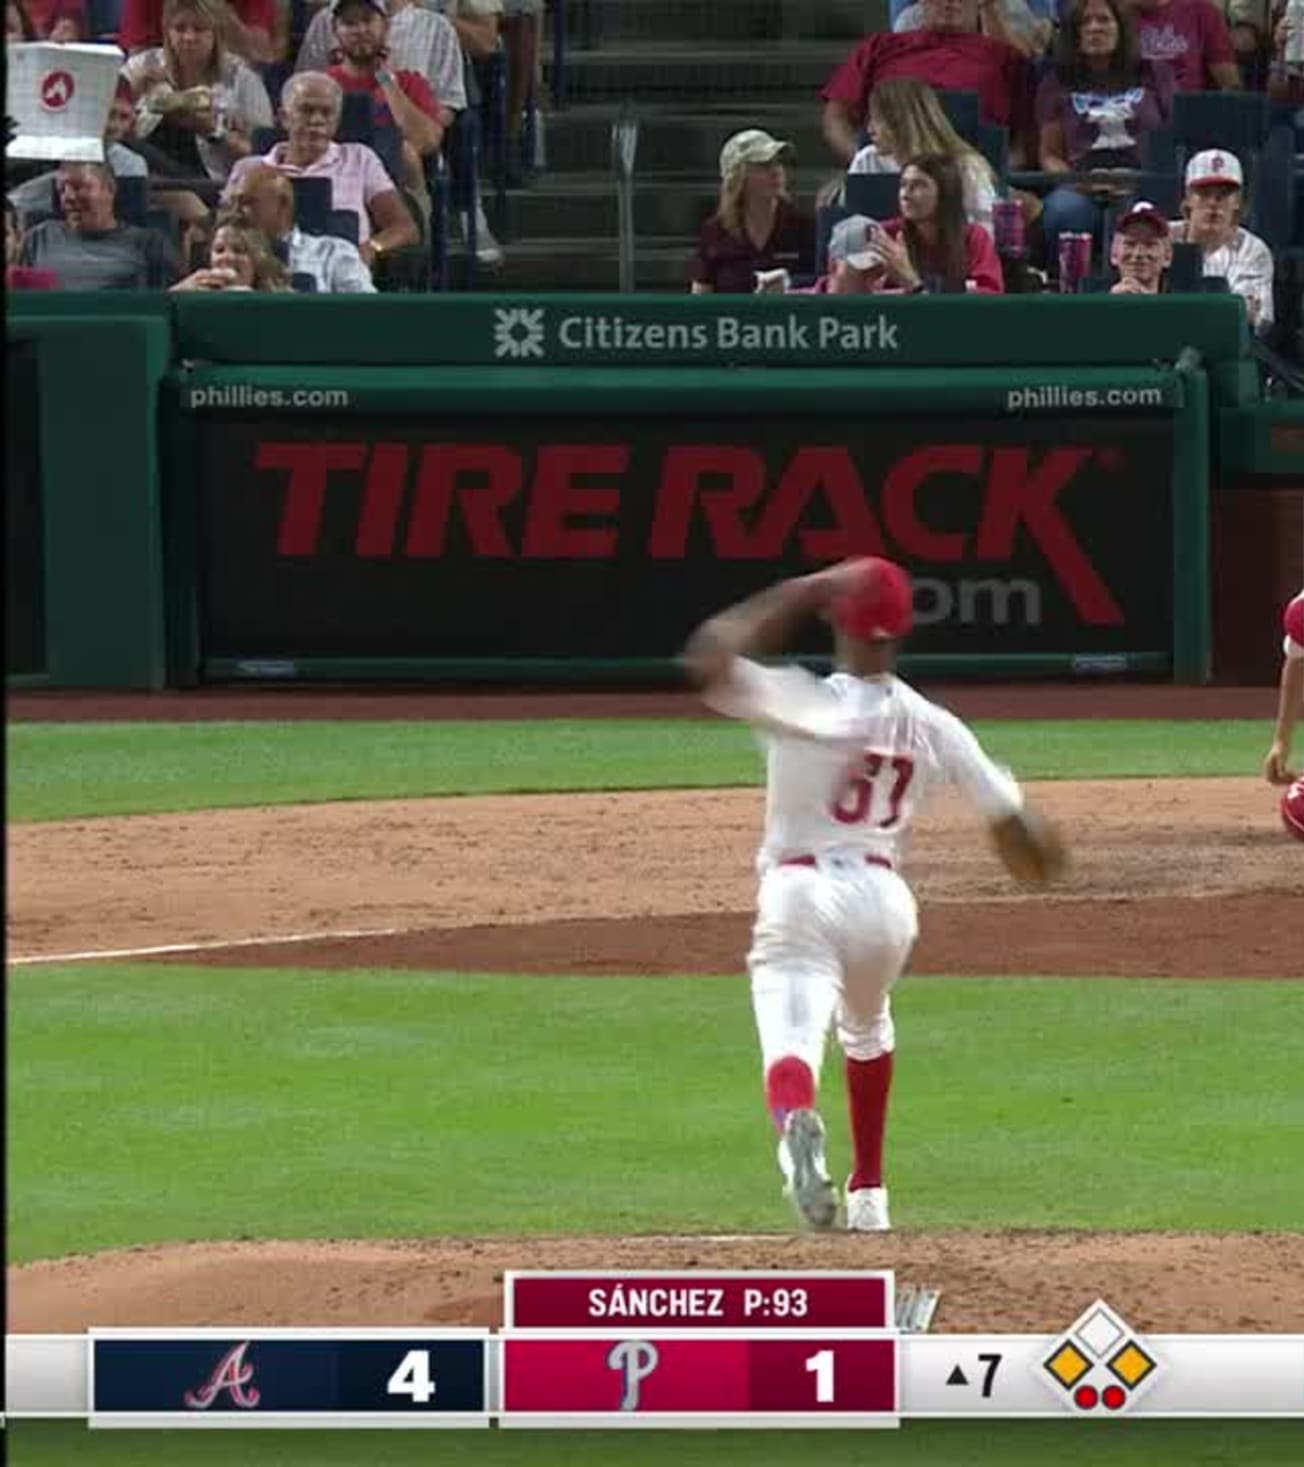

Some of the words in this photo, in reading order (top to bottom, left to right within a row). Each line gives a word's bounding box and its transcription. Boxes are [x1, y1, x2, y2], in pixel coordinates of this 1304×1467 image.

[558, 315, 714, 350] Citizens
[717, 314, 809, 350] Bank
[818, 314, 899, 350] Park
[189, 385, 349, 409] phillies.com
[1006, 386, 1162, 409] phillies.com
[253, 441, 631, 559] TIRE
[648, 443, 1125, 626] RACK
[913, 577, 1042, 625] om
